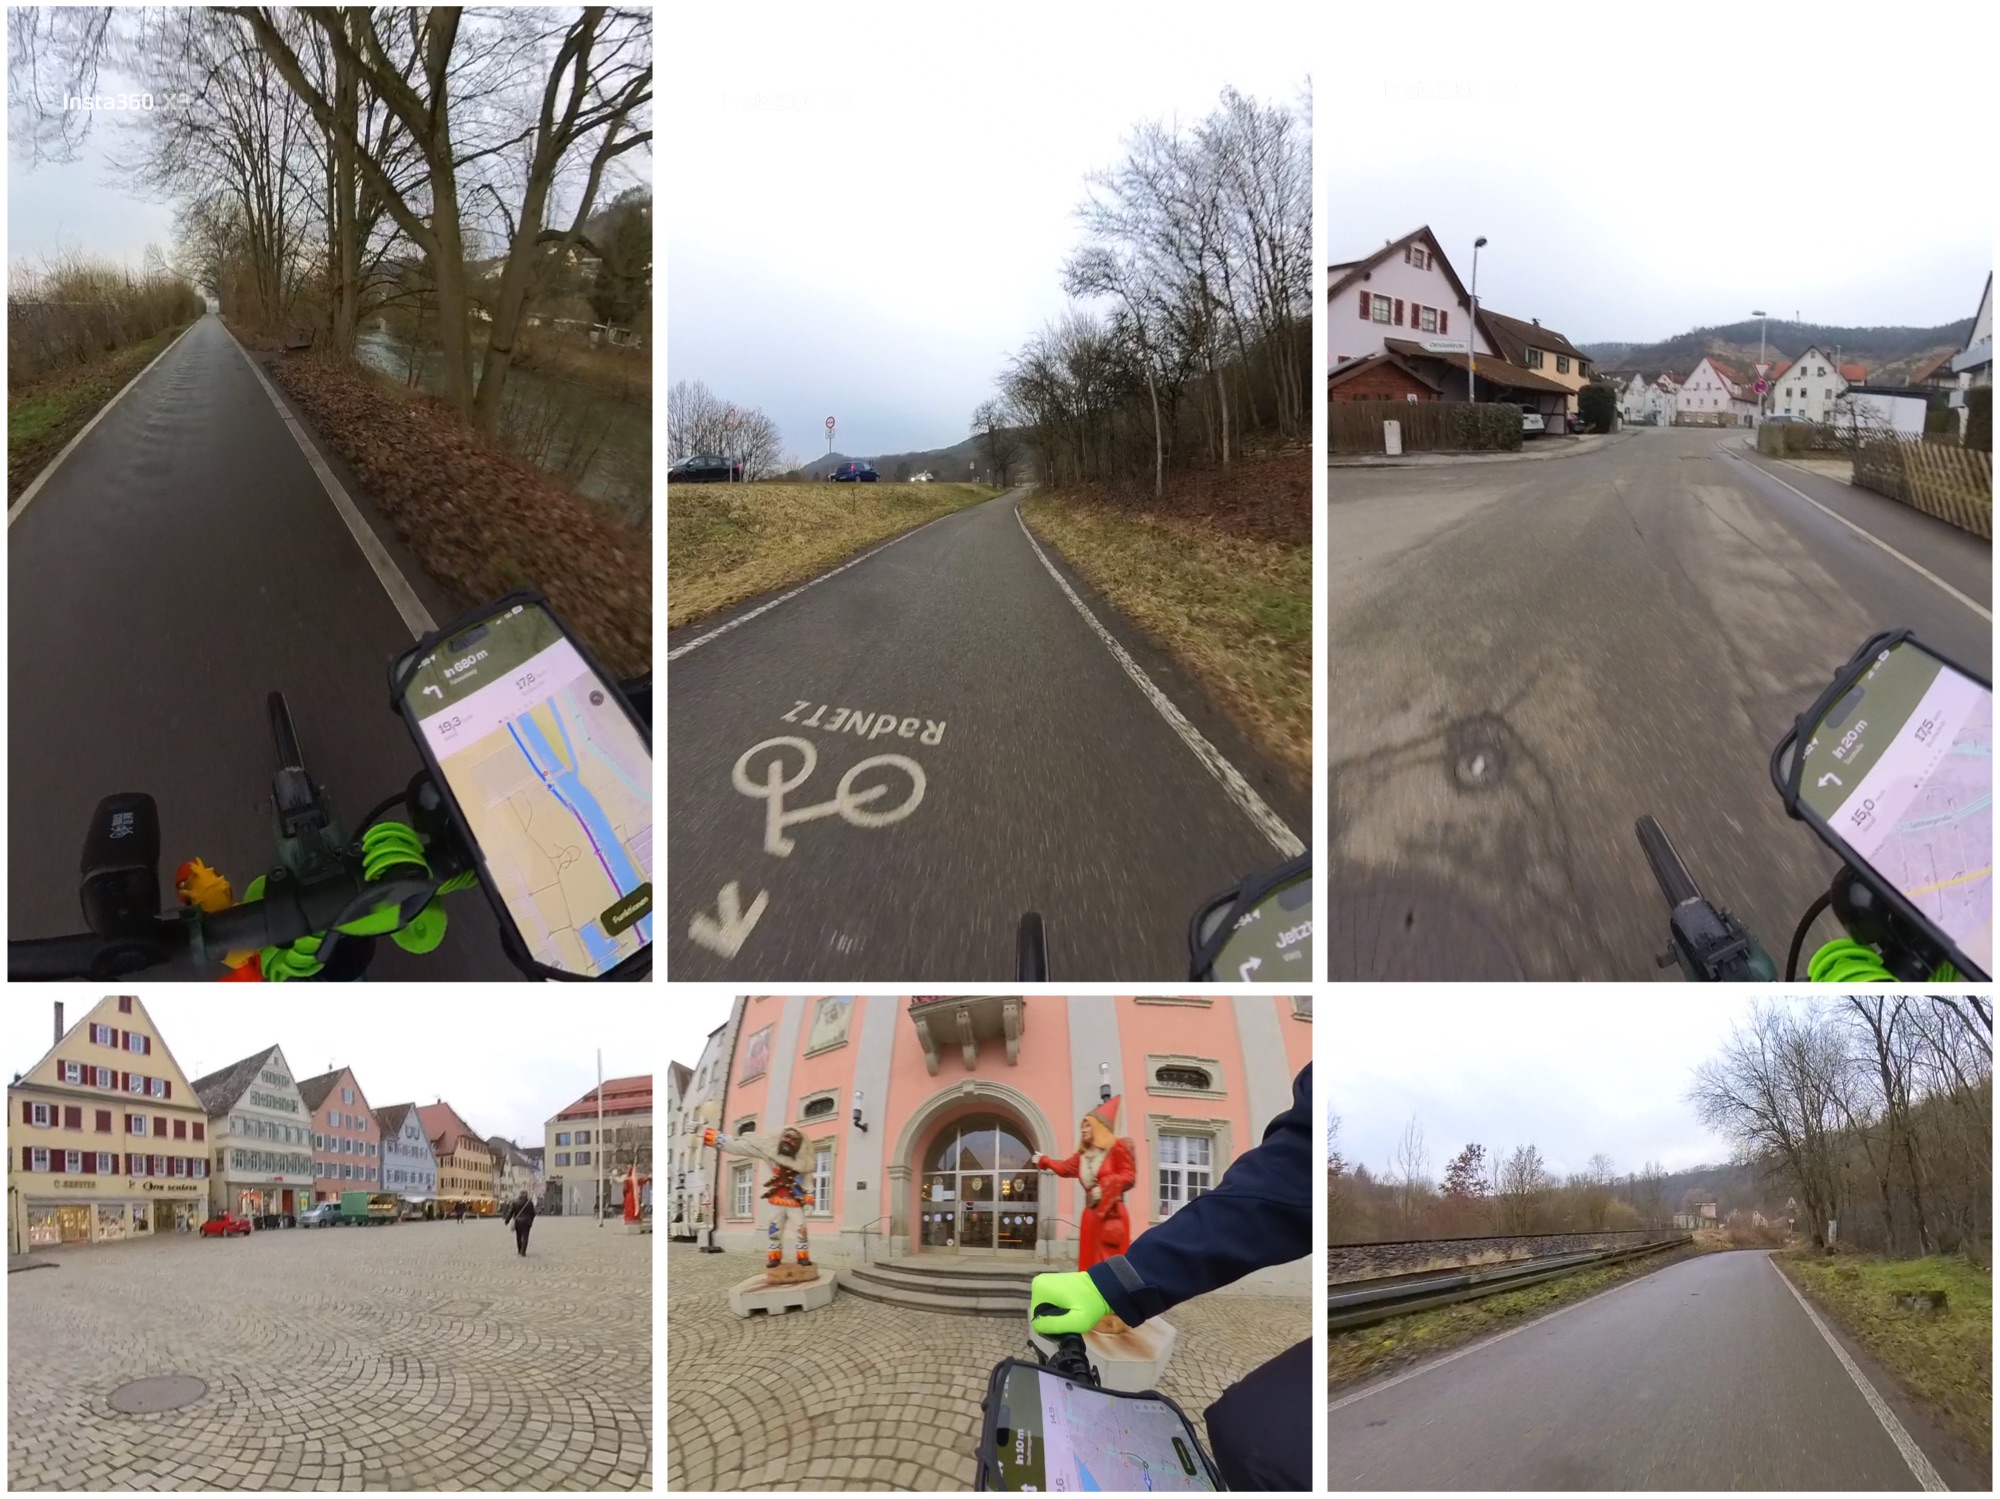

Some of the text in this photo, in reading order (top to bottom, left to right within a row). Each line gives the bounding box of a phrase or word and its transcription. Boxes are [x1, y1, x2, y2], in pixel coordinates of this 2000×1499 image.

[454, 655, 477, 673] 680
[476, 649, 489, 661] m
[516, 673, 536, 690] 17,8
[438, 716, 462, 734] 19,3
[780, 700, 947, 746] RadNETZ
[1841, 729, 1858, 750] 20
[1854, 719, 1868, 734] m
[1914, 719, 1935, 743] 17,5
[1851, 798, 1876, 826] 15,0
[612, 896, 649, 924] Funktionen
[1017, 1428, 1025, 1440] m
[1015, 1439, 1025, 1454] 10
